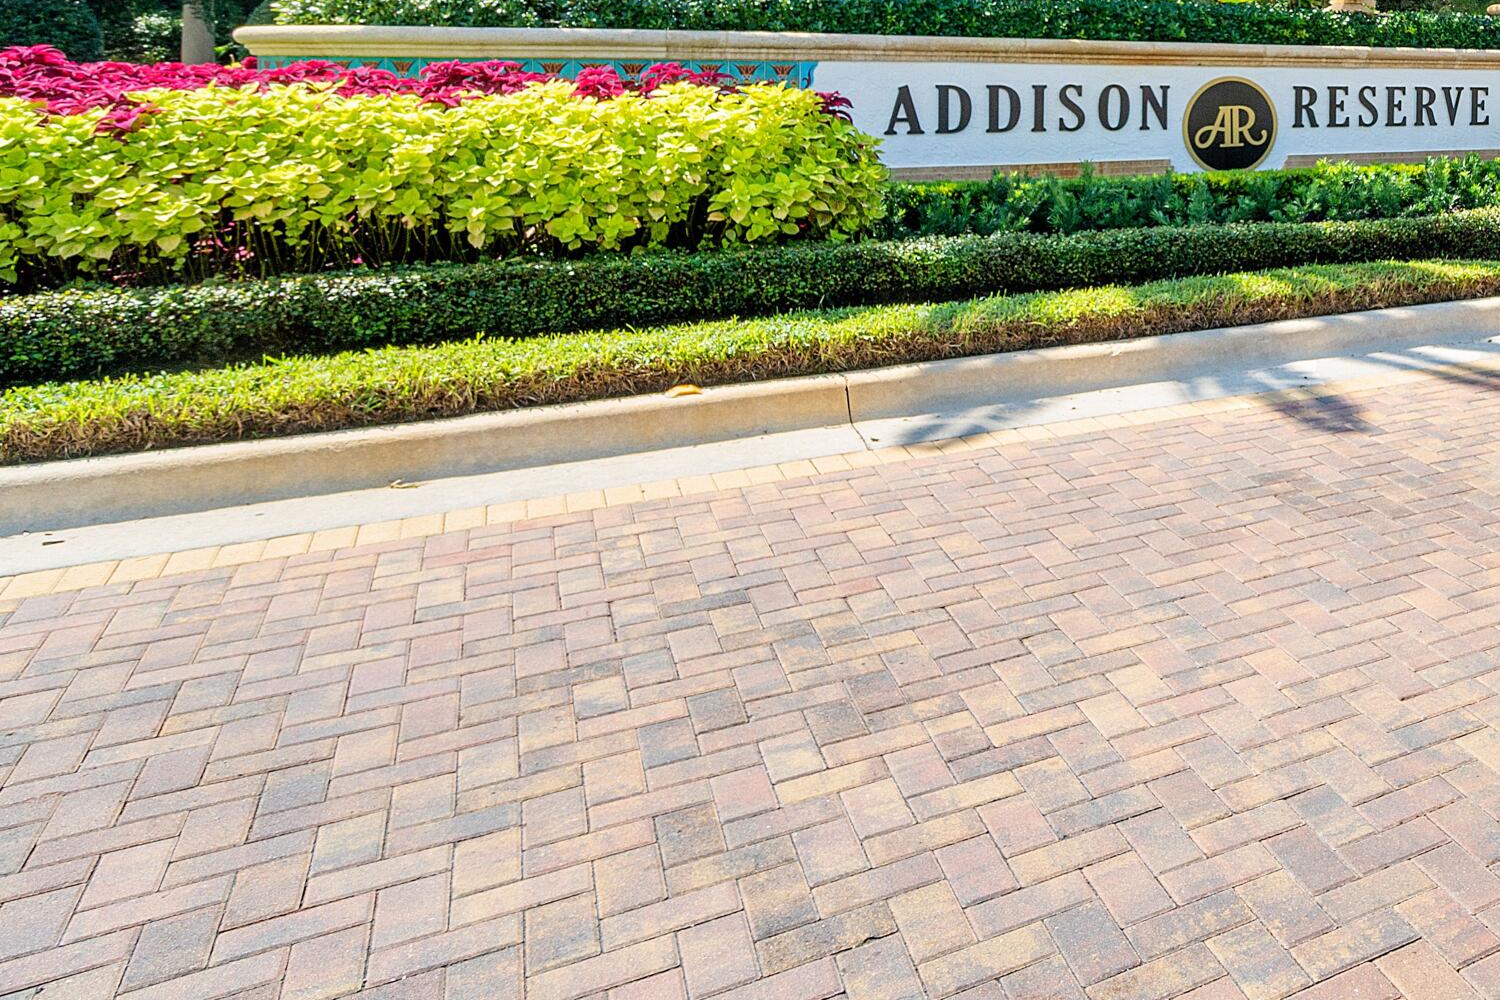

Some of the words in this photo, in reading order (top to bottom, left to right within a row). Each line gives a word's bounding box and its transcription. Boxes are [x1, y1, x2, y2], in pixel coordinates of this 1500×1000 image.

[884, 84, 1170, 135] ADDISON
[1292, 85, 1490, 128] RESERVE
[1194, 105, 1268, 149] AR
